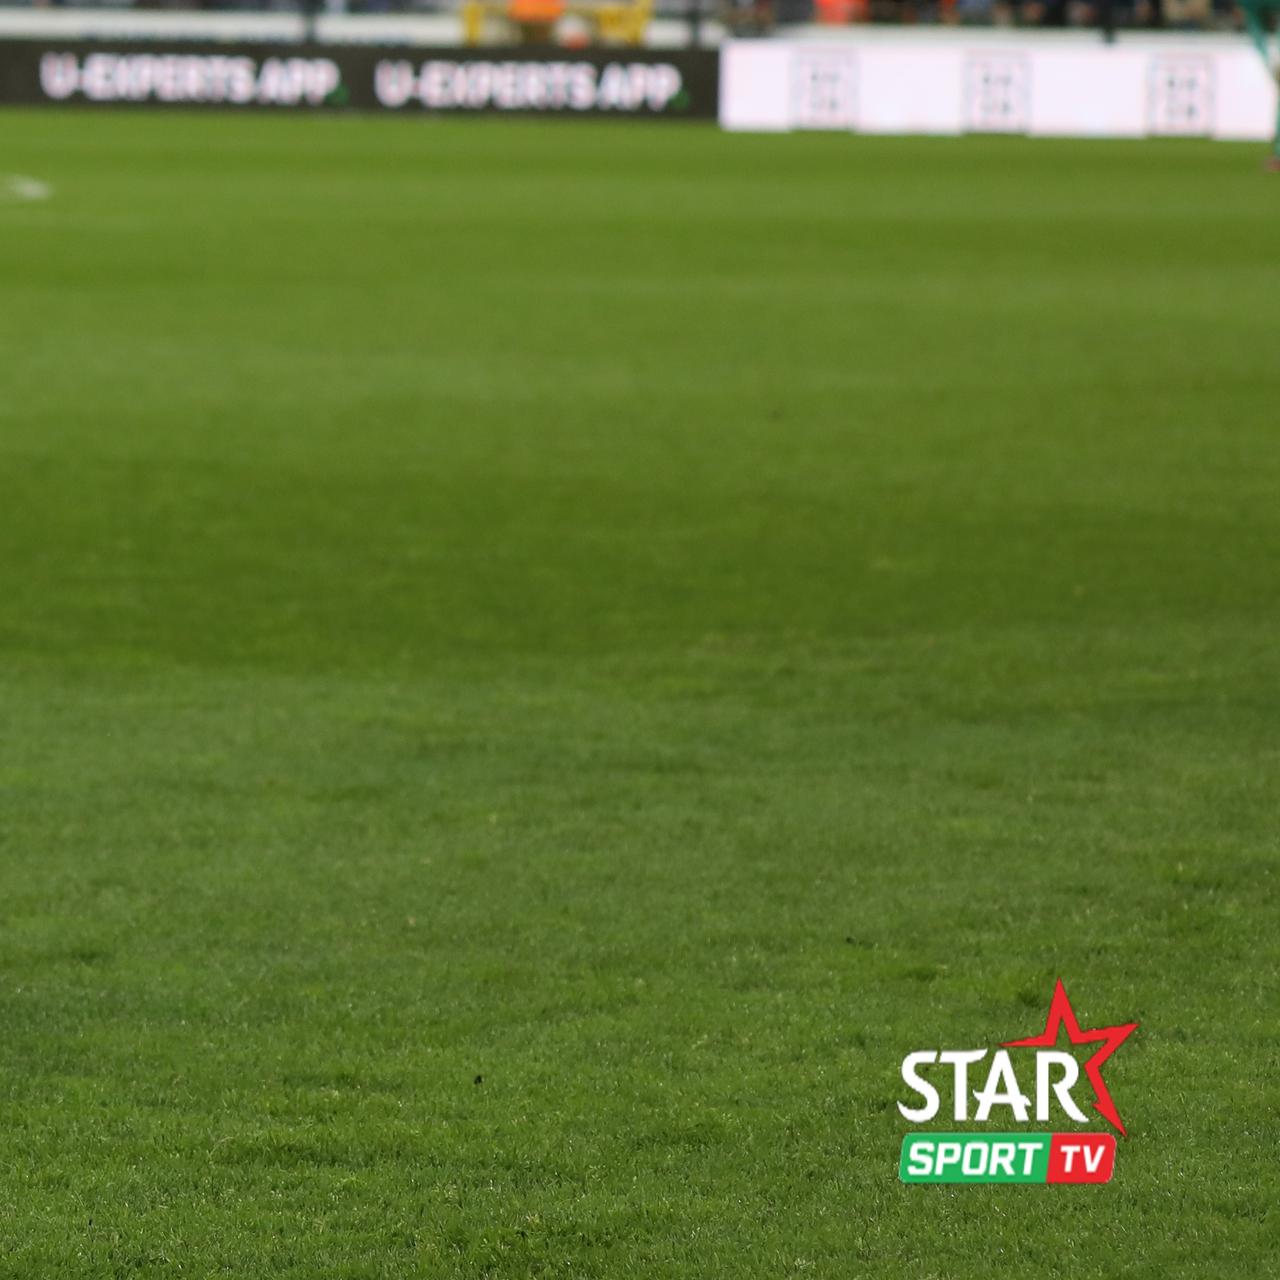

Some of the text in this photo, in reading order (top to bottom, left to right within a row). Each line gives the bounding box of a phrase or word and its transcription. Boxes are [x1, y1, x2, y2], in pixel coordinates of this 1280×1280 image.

[41, 52, 340, 106] U-EXPERTS APP
[376, 61, 681, 112] U-EXPERTS APP
